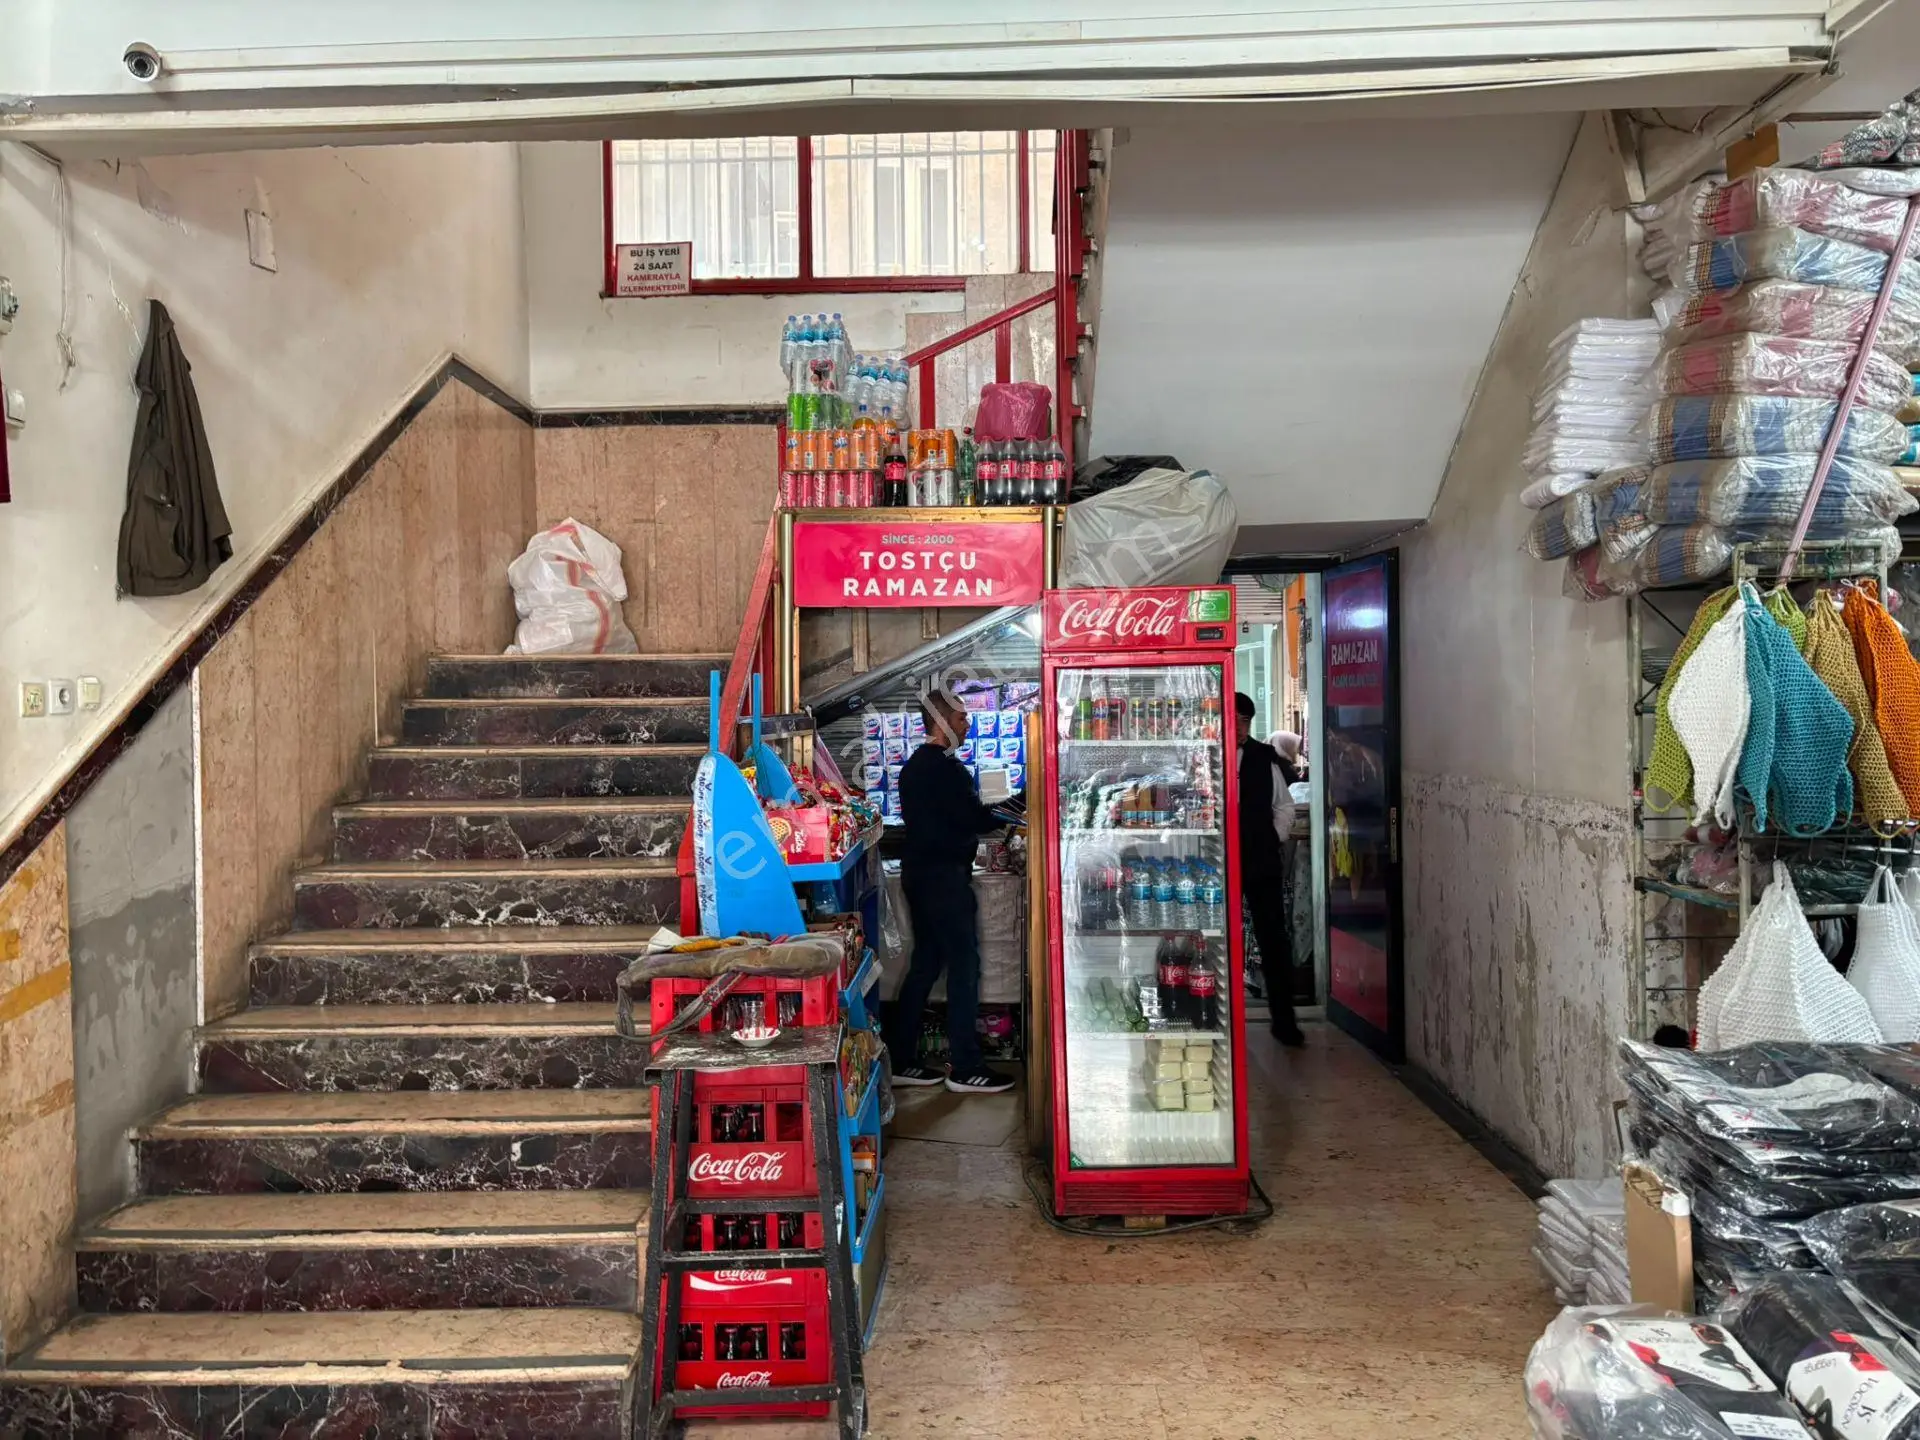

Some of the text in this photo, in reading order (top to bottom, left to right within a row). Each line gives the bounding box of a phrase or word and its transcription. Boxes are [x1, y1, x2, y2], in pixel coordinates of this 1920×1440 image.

[646, 248, 655, 258] İŞ
[658, 246, 680, 256] YERİ
[648, 262, 673, 270] SAAT
[627, 273, 680, 281] KAMERAYLA
[620, 283, 686, 292] İZLENMEKTEDİR
[924, 535, 954, 544] 2000
[859, 551, 977, 574] TOSTÇU
[843, 578, 992, 597] RAMAZAN
[1059, 594, 1181, 638] Coca-Cola
[1331, 640, 1378, 666] RAMAZAN
[689, 1151, 788, 1182] Coca-Cola
